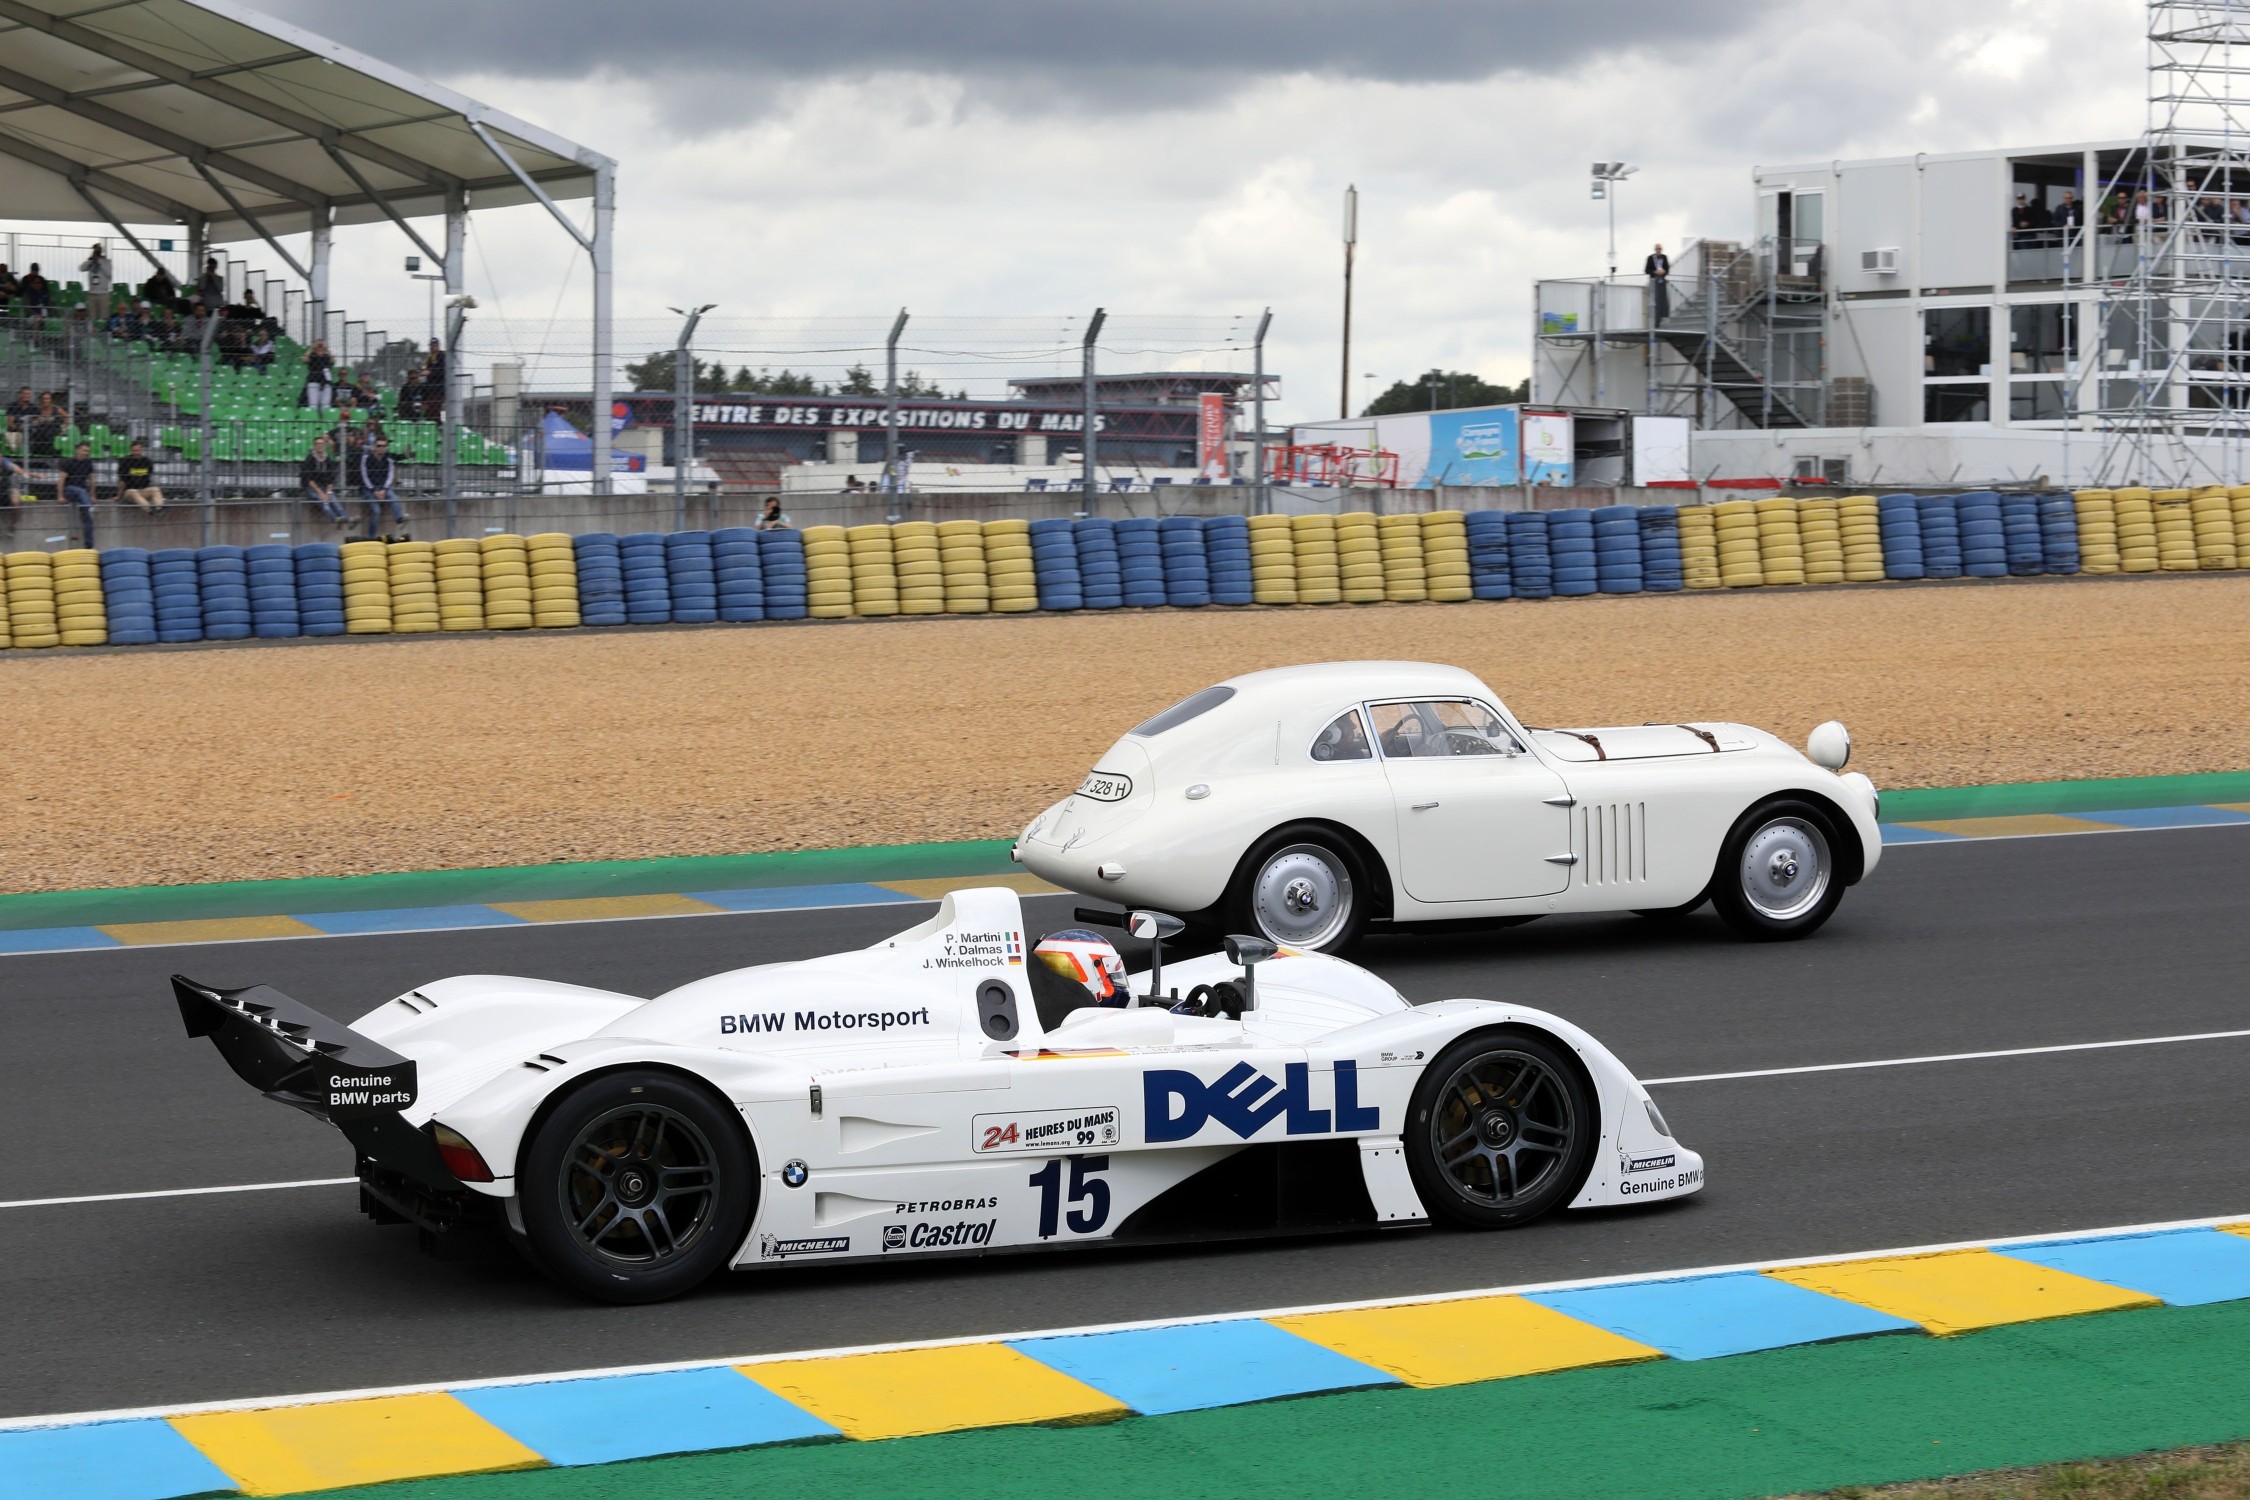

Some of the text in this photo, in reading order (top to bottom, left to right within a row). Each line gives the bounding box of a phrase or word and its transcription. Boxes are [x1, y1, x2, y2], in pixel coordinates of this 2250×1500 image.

[673, 405, 760, 424] ENTRE
[774, 407, 819, 425] DES
[831, 408, 985, 429] EXPOSITIONS
[997, 412, 1030, 430] DU
[1089, 780, 1113, 795] 328
[1114, 782, 1127, 797] H
[946, 932, 1001, 943] P. Martini
[944, 944, 1003, 956] Y. Dalmas
[922, 956, 1004, 969] J. Winkelhock
[720, 1007, 929, 1034] BMW Motorsport
[329, 1074, 392, 1088] Genuine
[330, 1091, 411, 1107] BMW parts
[1143, 1059, 1380, 1143] DELL
[981, 1122, 1020, 1150] 24
[1025, 1121, 1065, 1141] HEURES
[1067, 1117, 1082, 1132] DU
[1084, 1111, 1114, 1128] MANS
[1025, 1139, 1071, 1148] www.lemans.org
[1076, 1130, 1095, 1145] 99
[1633, 1157, 1675, 1169] MICHELIN
[1620, 1178, 1675, 1195] Genuine
[1678, 1169, 1699, 1187] BMW
[1029, 1155, 1111, 1237] 15
[896, 1197, 998, 1214] PETROBRAS
[910, 1218, 997, 1248] Castrol
[779, 1240, 848, 1252] MICHELIN
